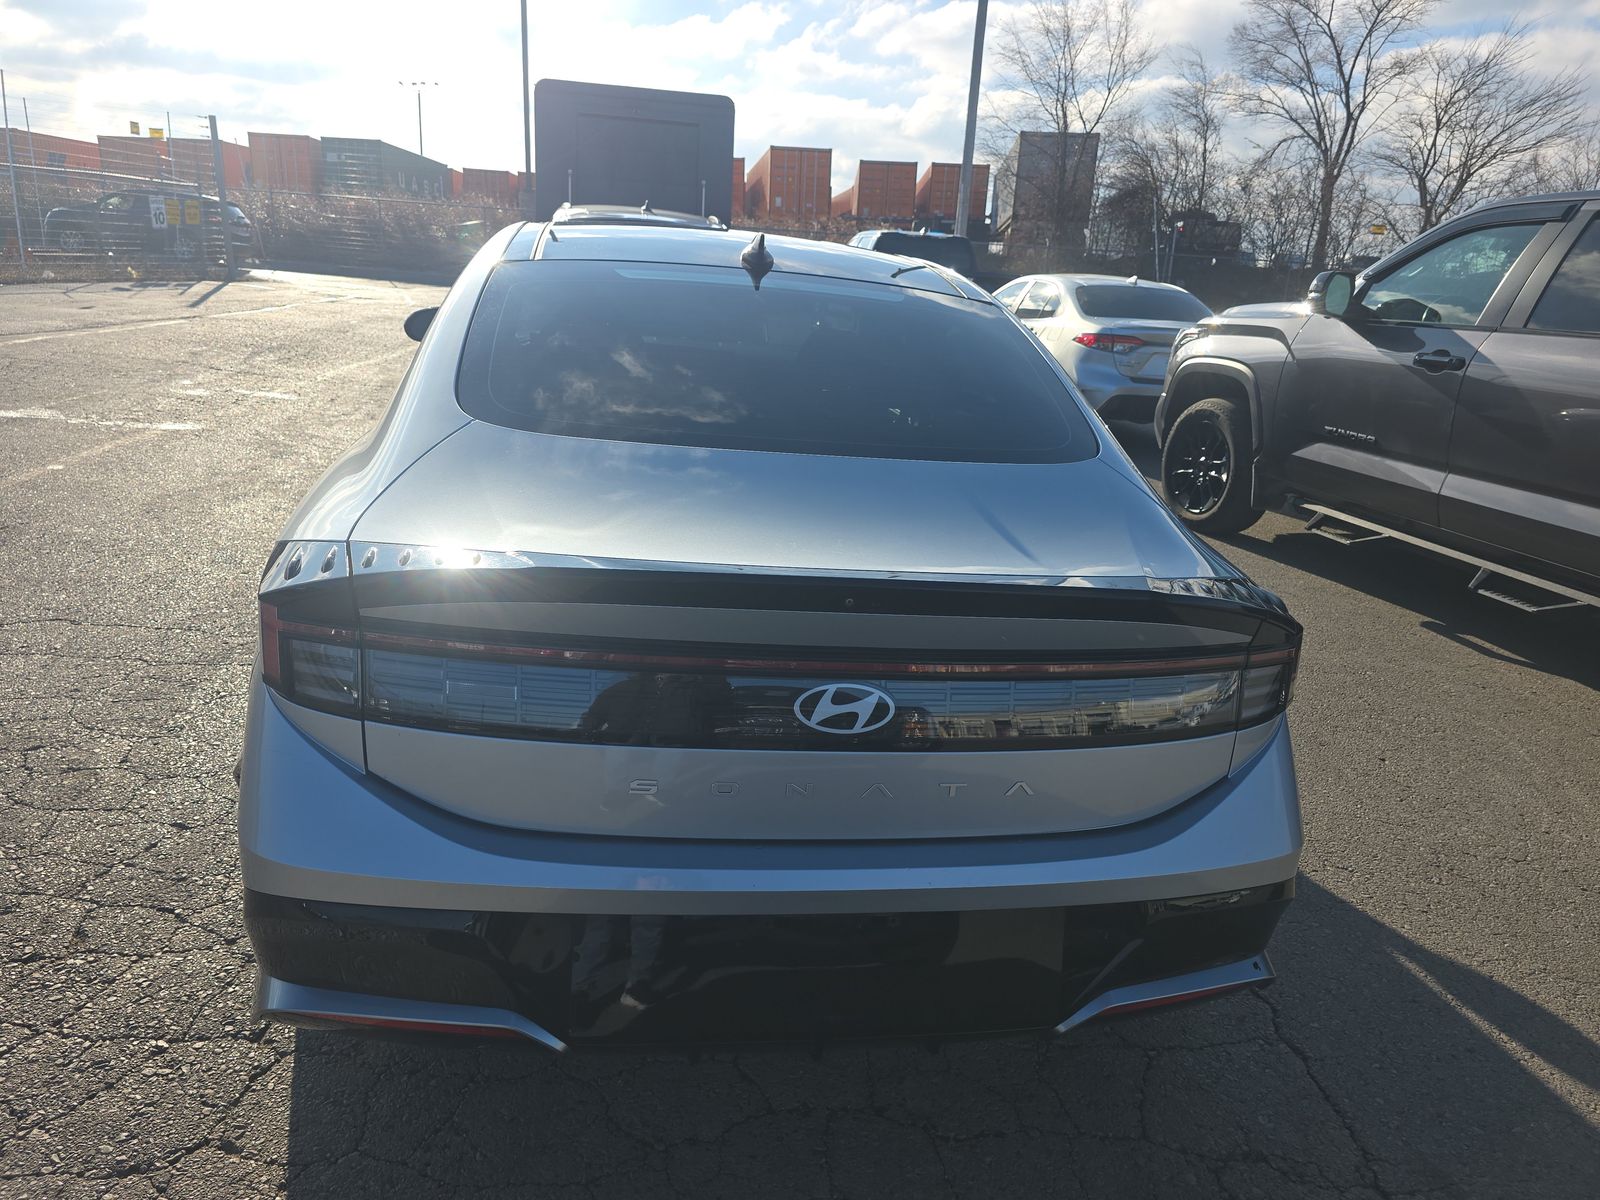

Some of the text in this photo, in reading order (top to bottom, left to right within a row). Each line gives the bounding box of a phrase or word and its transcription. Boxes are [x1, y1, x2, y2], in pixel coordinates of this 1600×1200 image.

[153, 211, 165, 225] 10
[1323, 425, 1376, 441] TUNDRA
[628, 779, 1035, 799] SONATA
